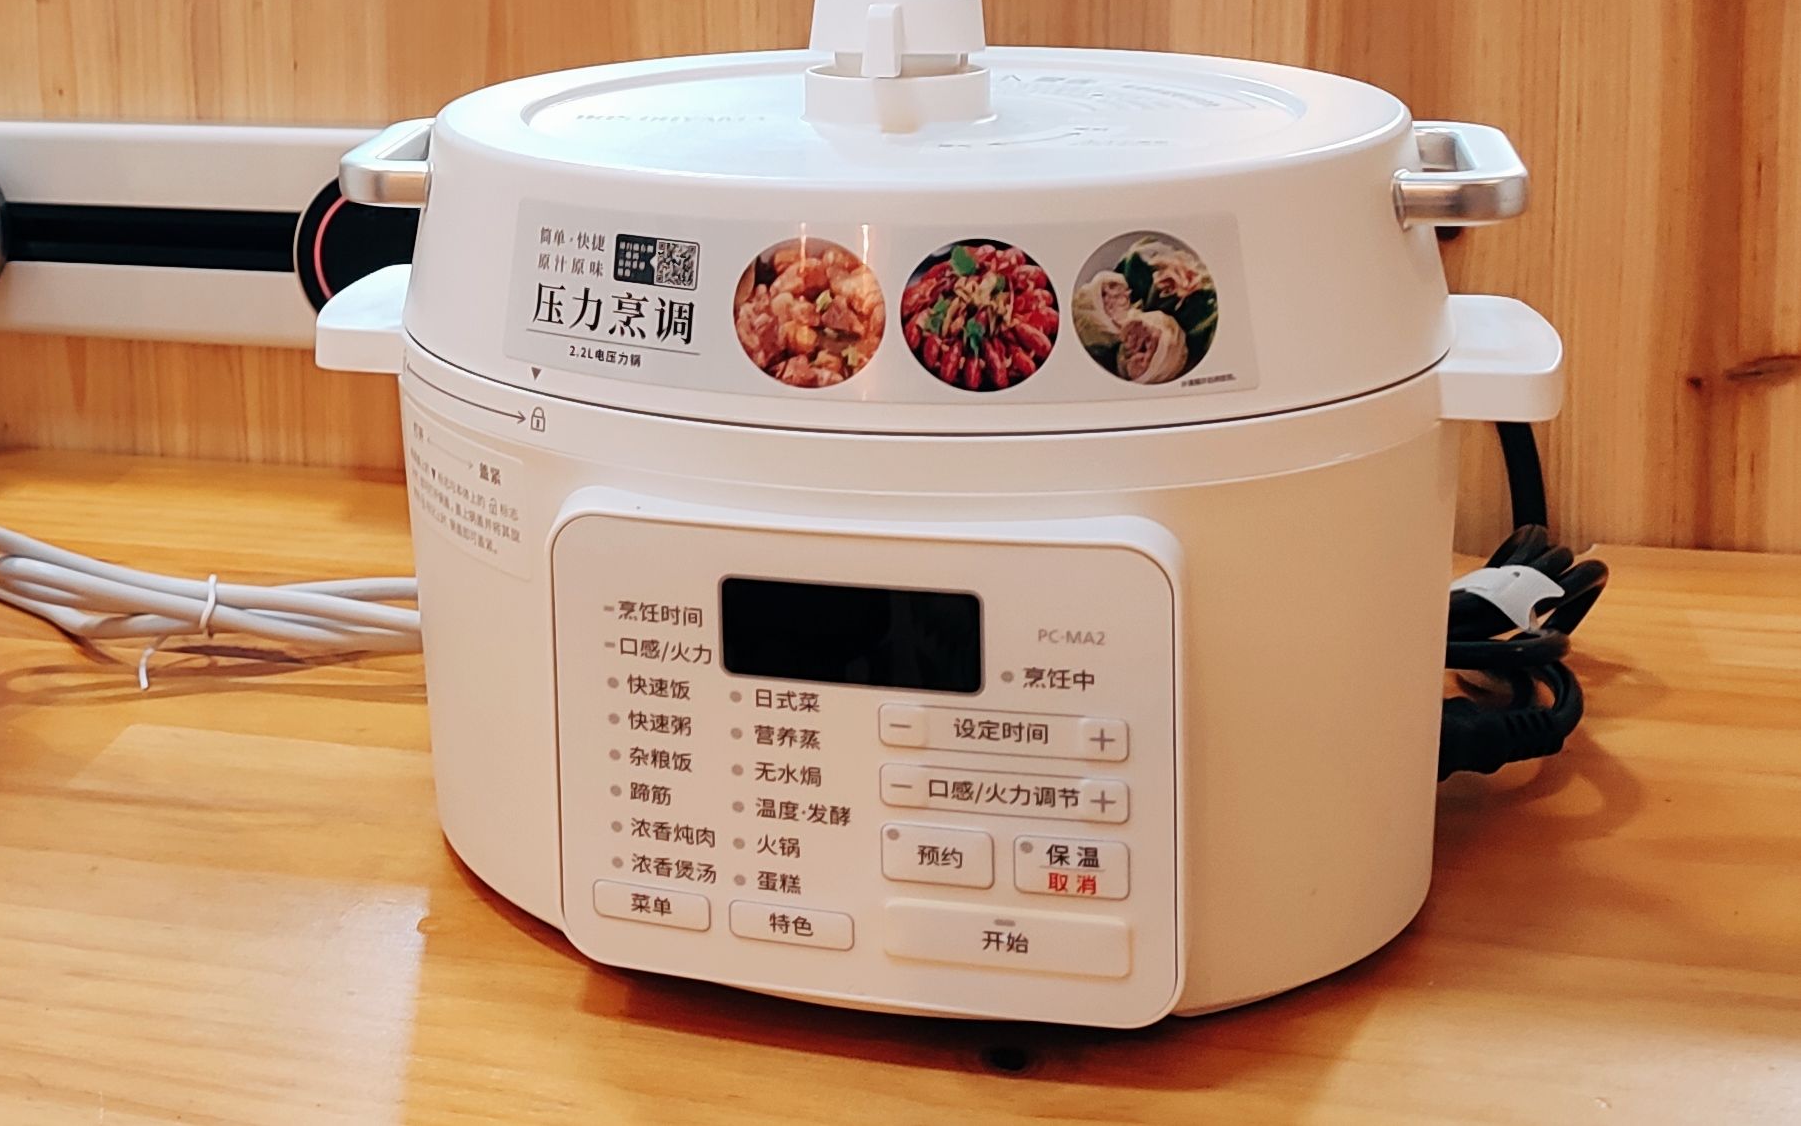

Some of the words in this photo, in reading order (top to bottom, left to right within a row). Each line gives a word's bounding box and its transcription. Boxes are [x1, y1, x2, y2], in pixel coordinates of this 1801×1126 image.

[538, 253, 604, 278] 原汁原味
[532, 283, 694, 345] 压力烹调
[569, 345, 641, 368] 2.2L电压力锅
[618, 600, 703, 628] 烹饪时间
[620, 637, 712, 665] 口感/火力
[627, 673, 691, 701] 快速饭
[1023, 667, 1096, 692] 烹饪中
[755, 688, 821, 713] 日式菜
[628, 709, 692, 736] 快速粥
[954, 718, 1049, 745] 设定时间
[754, 724, 821, 750] 营养蒸
[629, 746, 693, 773] 杂粮饭
[755, 761, 822, 788] 无水焗
[630, 781, 672, 806] 蹄筋
[928, 779, 1081, 809] 口感/火力调节
[630, 817, 717, 849] 浓香炖肉
[757, 833, 801, 859] 火锅
[631, 852, 718, 885] 浓香煲汤
[917, 844, 964, 869] 预约
[1046, 843, 1101, 868] 保温
[757, 870, 802, 895] 蛋糕
[1048, 872, 1098, 896] 取消
[630, 892, 673, 917] 菜单
[768, 911, 814, 937] 特色
[981, 929, 1030, 954] 开始
